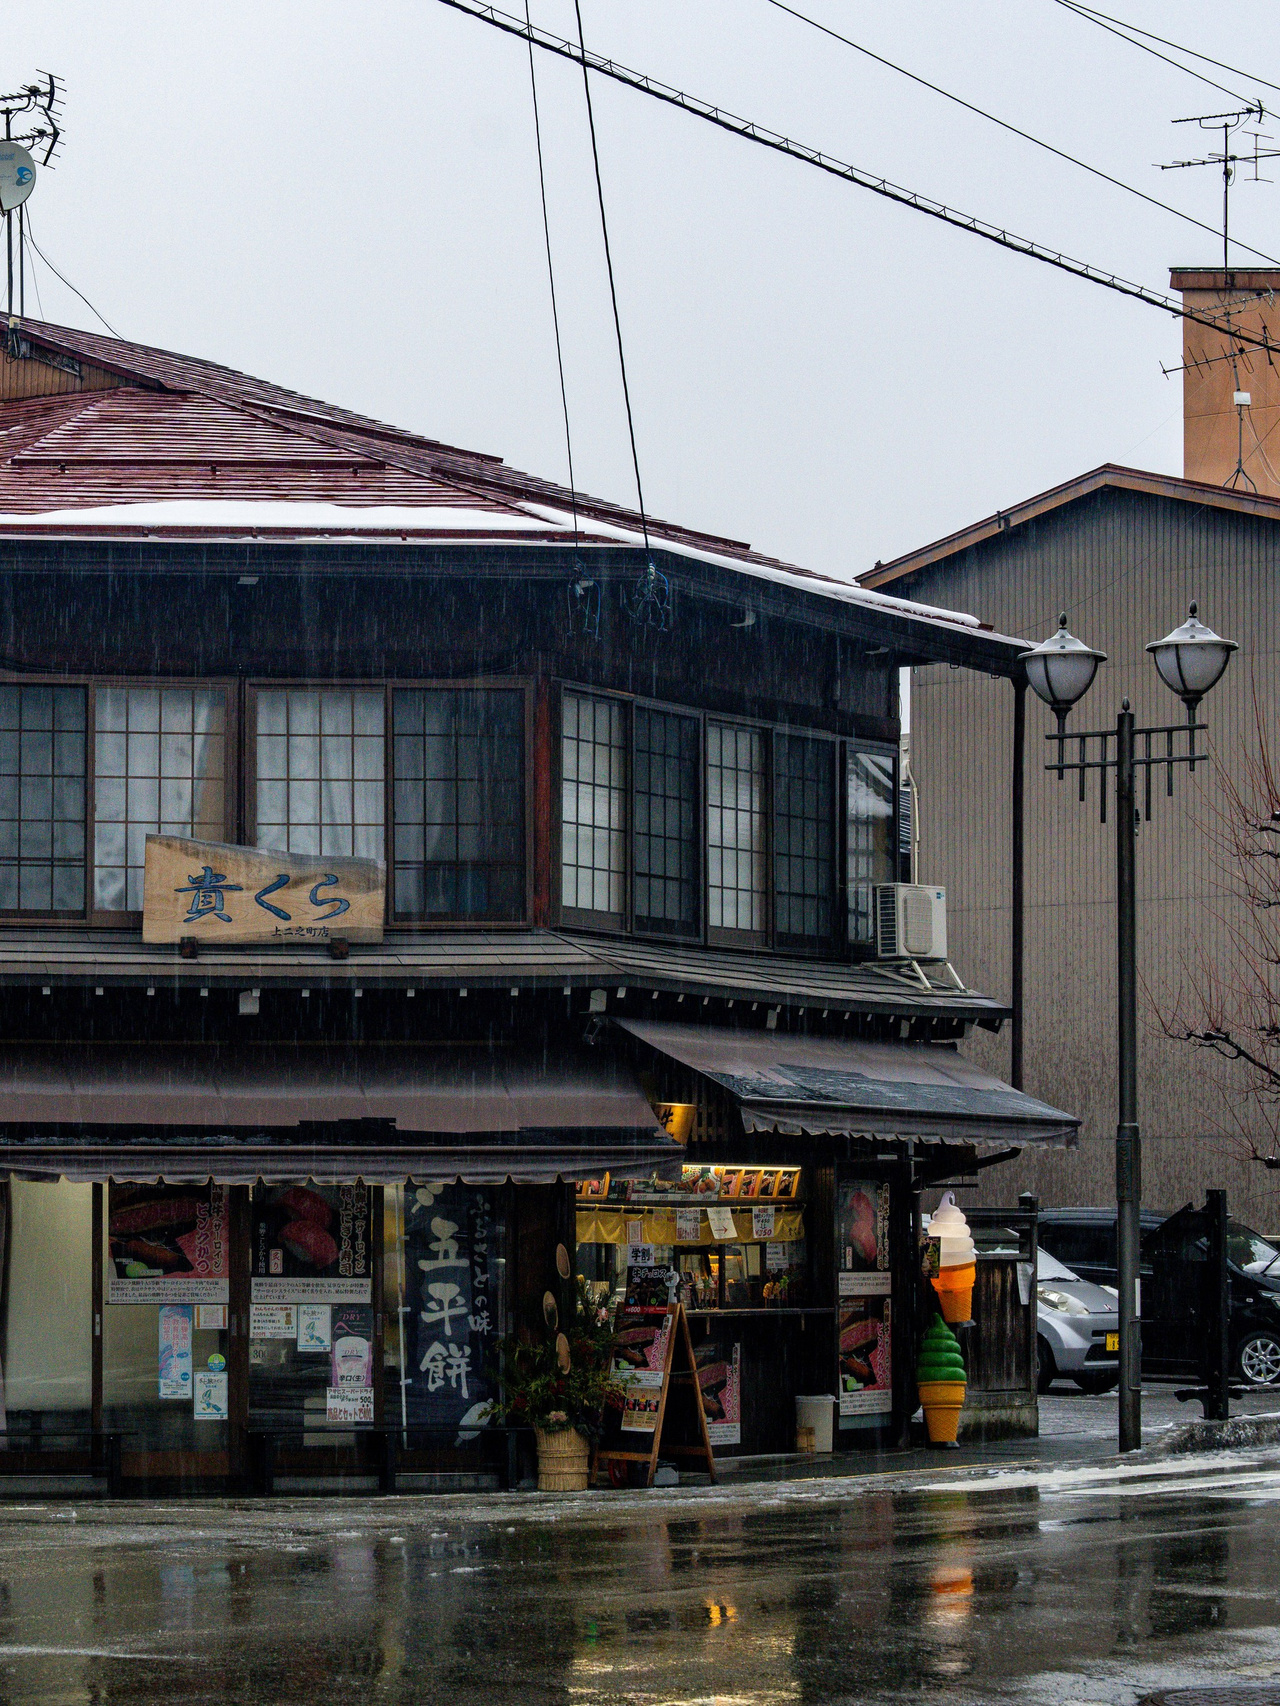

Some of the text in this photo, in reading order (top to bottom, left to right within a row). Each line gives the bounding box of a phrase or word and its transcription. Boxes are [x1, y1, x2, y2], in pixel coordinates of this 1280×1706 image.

[174, 866, 351, 923] 貴くら
[271, 925, 329, 938] 上二之町店
[196, 1202, 210, 1273] ピンクかつ
[631, 1247, 651, 1261] 学割
[417, 1216, 473, 1400] 五平餅
